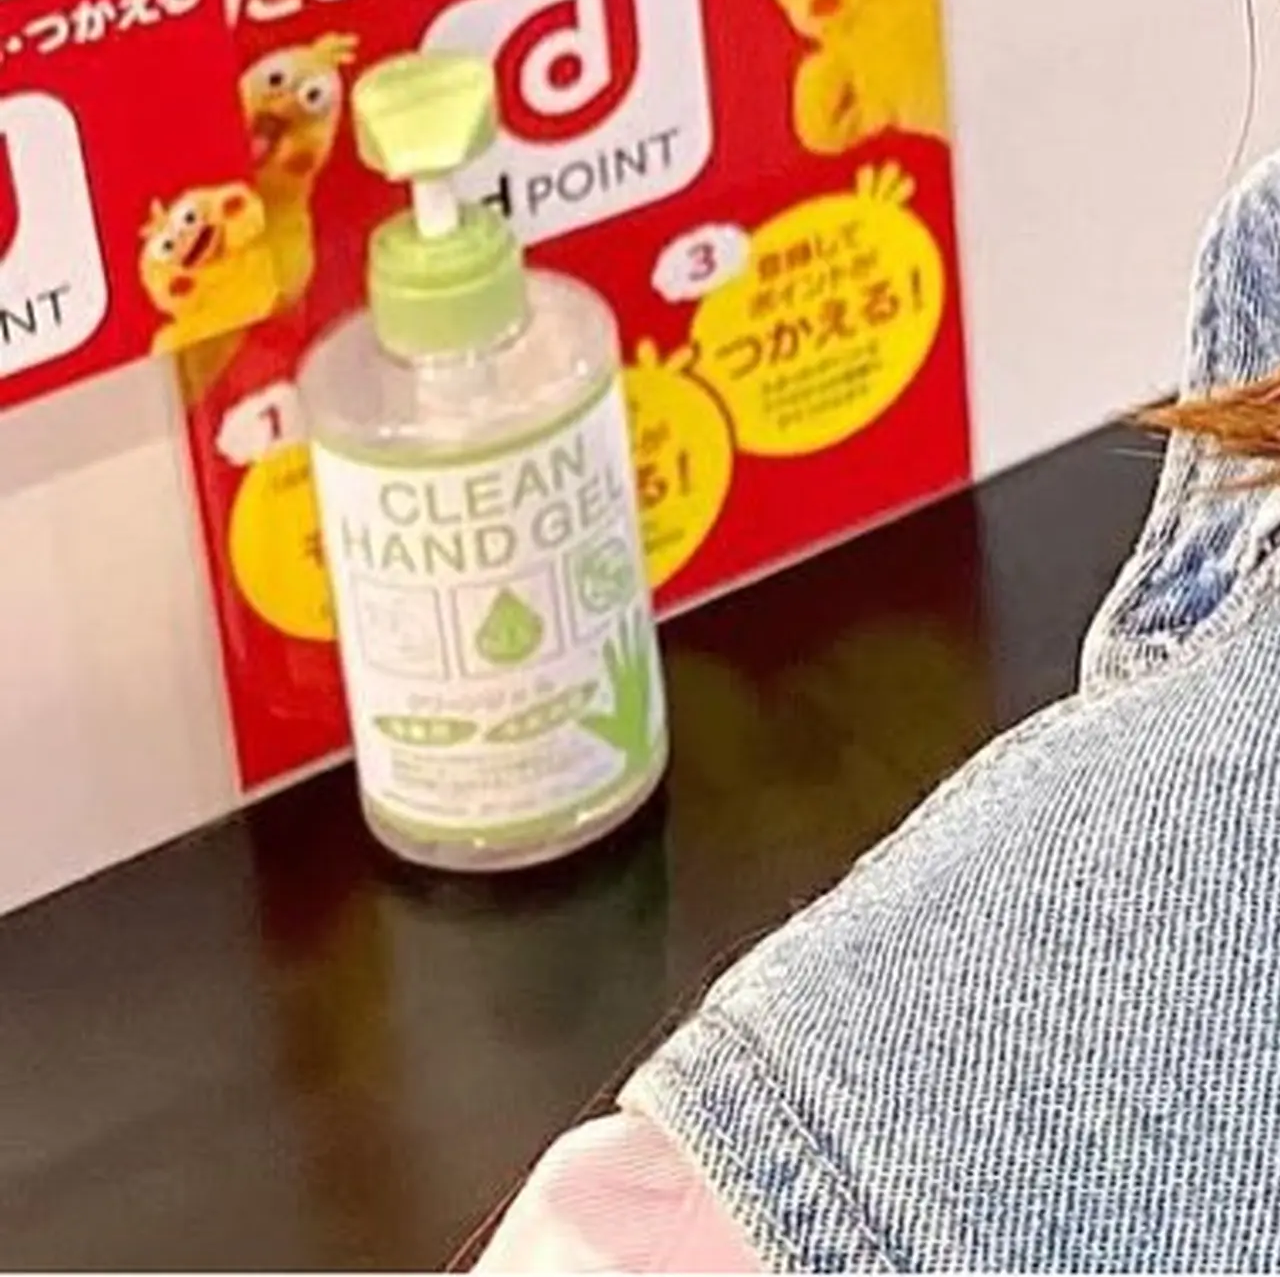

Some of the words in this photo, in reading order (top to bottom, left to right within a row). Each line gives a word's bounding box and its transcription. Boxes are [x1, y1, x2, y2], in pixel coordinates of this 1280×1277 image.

[526, 128, 679, 216] POINT
[686, 243, 716, 282] 3
[258, 402, 282, 440] 1
[340, 514, 518, 575] HAND
[530, 464, 625, 549] GEL
[379, 430, 587, 527] CLEAN
